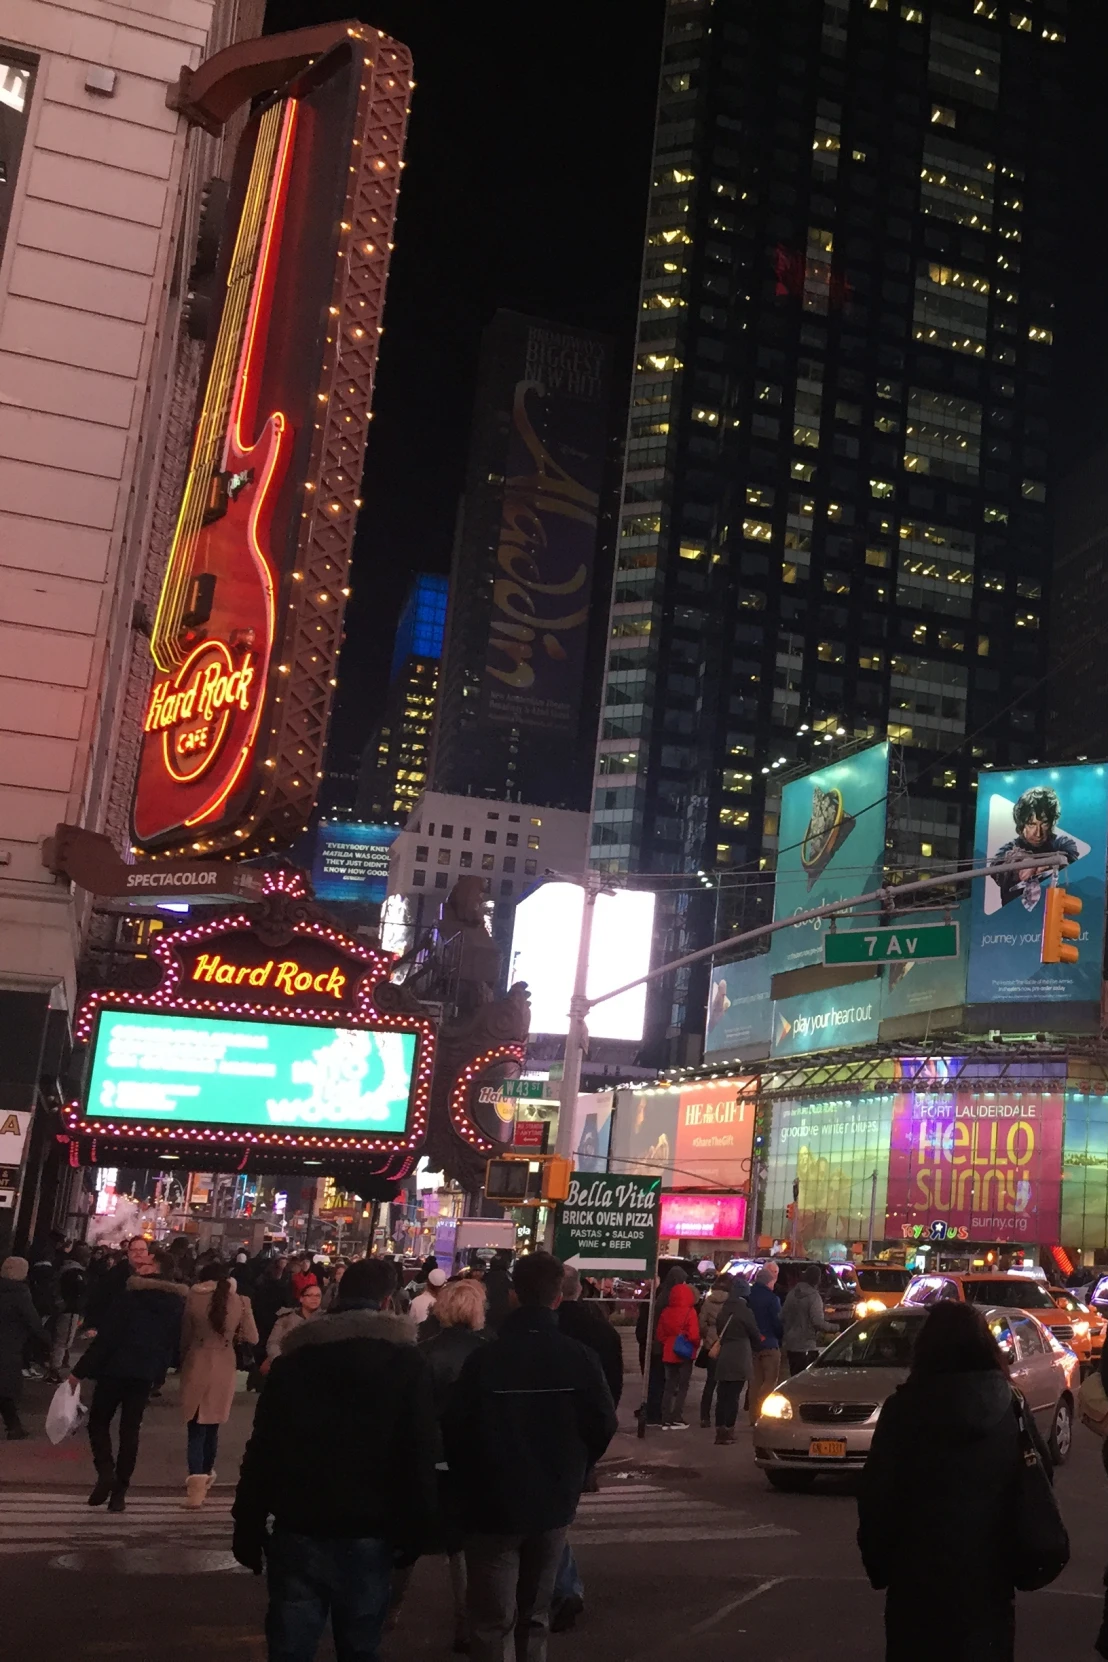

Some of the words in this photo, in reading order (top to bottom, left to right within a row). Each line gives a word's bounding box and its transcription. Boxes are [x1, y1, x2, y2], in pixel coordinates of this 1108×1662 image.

[526, 342, 601, 378] BIGGEST
[145, 671, 202, 731] Hard
[197, 653, 254, 721] Rock
[326, 858, 344, 866] THEY
[127, 871, 217, 887] SPECTACOLOR
[348, 867, 366, 875] HOW
[864, 936, 877, 956] 7
[886, 935, 918, 955] Av
[981, 933, 1018, 947] journey
[1020, 933, 1042, 946] your
[192, 954, 274, 987] Hard
[274, 961, 346, 999] Rock
[793, 1014, 811, 1038] play
[811, 1012, 831, 1036] your
[831, 1006, 855, 1026] heart
[856, 1003, 873, 1022] out
[506, 1081, 515, 1096] W
[516, 1081, 529, 1097] 43
[531, 1082, 541, 1091] ST
[685, 1104, 704, 1126] HE
[920, 1105, 952, 1118] FORT
[955, 1105, 1036, 1118] LAUDERDALE
[781, 1118, 819, 1142] goodbye
[692, 1135, 733, 1147] #ShareTheGift
[564, 1180, 612, 1208] Bella
[562, 1210, 594, 1225] BRICK
[596, 1211, 623, 1227] OVEN
[625, 1212, 654, 1228] PIZZA
[972, 1217, 1027, 1234] sunny.org
[570, 1229, 602, 1238] PASTAS
[612, 1231, 644, 1240] SALADS
[578, 1240, 599, 1248] WINE
[609, 1241, 631, 1250] BEER
